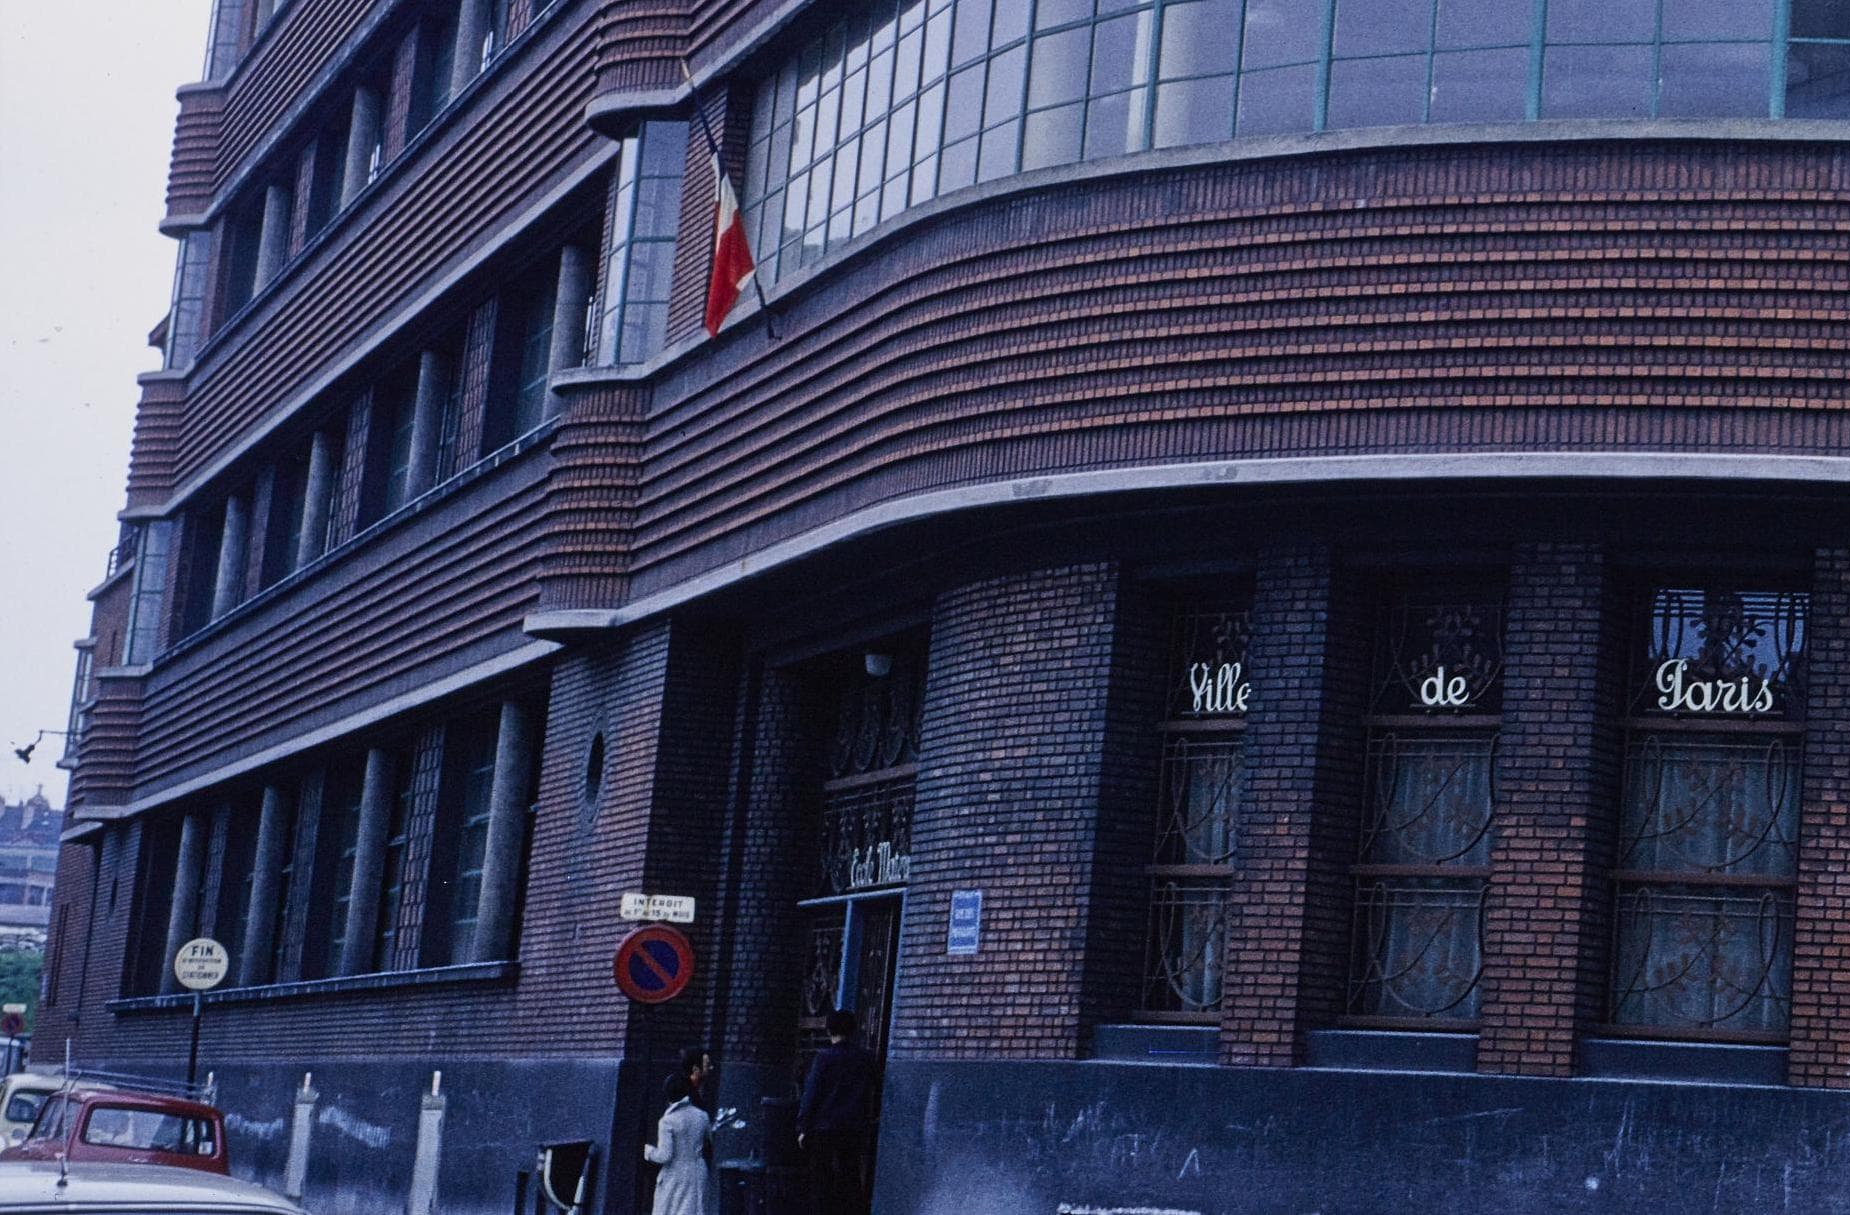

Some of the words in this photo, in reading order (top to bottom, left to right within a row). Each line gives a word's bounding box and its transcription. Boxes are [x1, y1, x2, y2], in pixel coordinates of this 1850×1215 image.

[1190, 662, 1251, 712] Ville
[1420, 667, 1470, 706] de
[1655, 659, 1774, 713] Paris
[633, 897, 684, 908] INTERDIT
[191, 945, 215, 956] FIN
